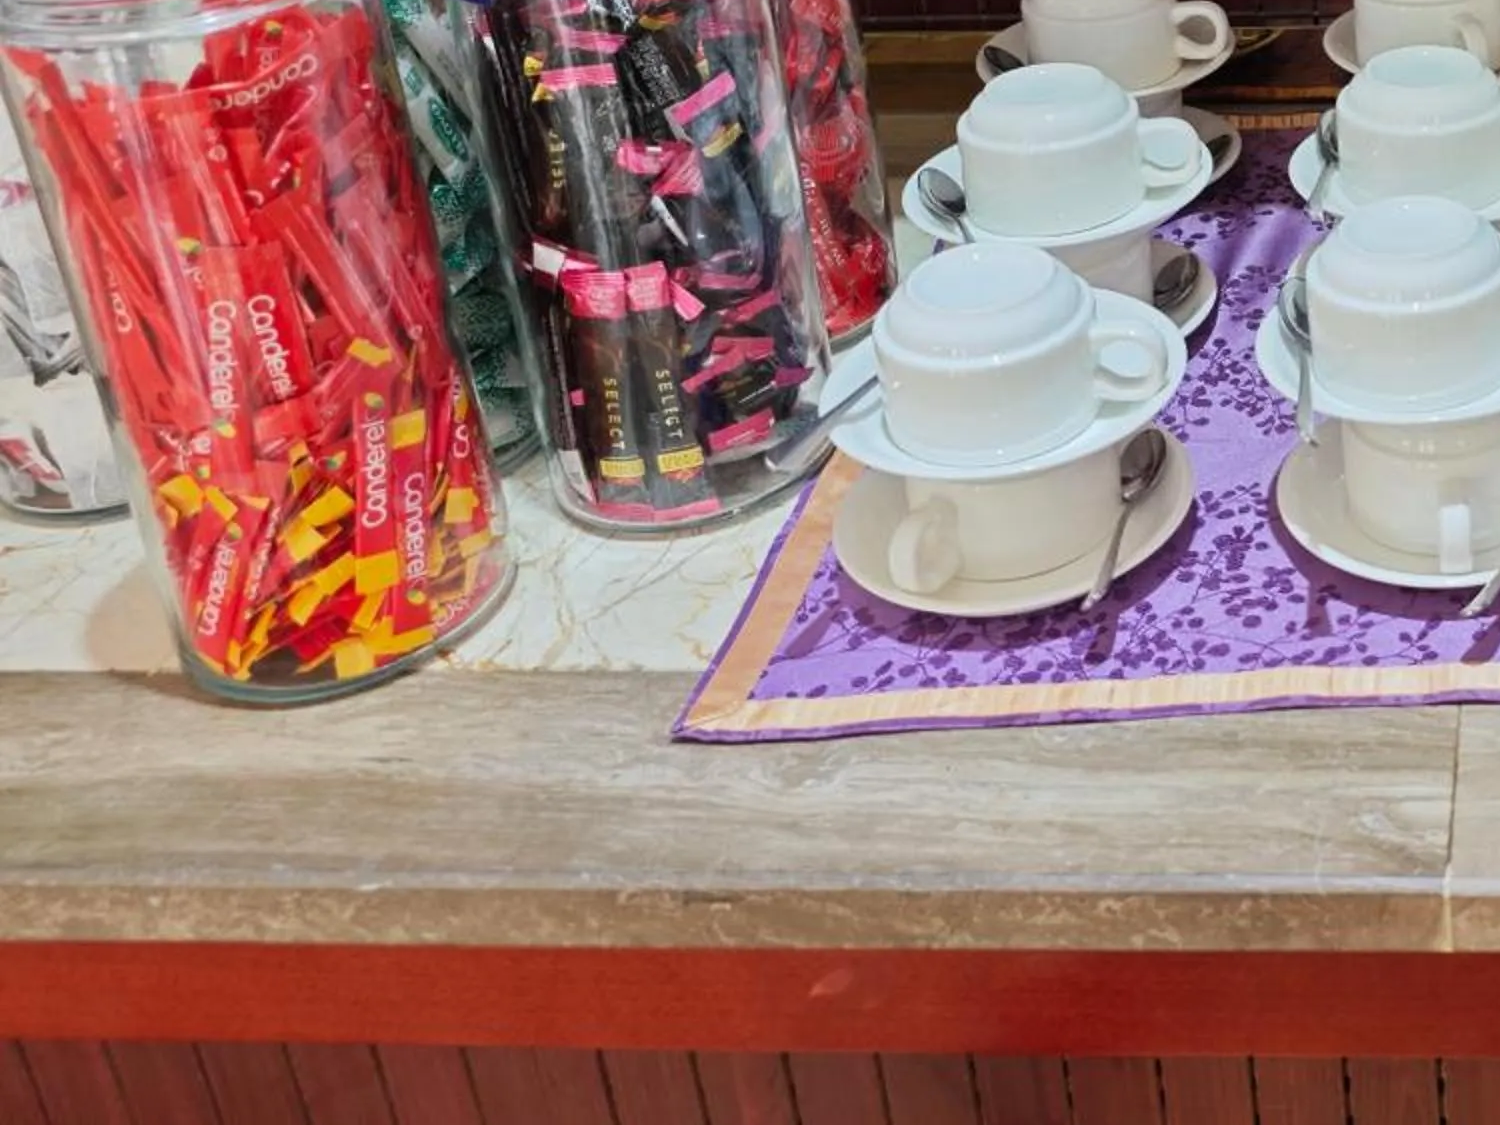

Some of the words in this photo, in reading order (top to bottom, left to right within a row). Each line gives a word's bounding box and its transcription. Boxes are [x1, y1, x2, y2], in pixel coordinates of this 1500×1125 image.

[208, 300, 240, 409] Canderel
[247, 294, 298, 400] Canderel
[603, 378, 627, 451] SELECT
[654, 369, 684, 440] SELECT
[360, 419, 388, 528] Canderel
[403, 472, 427, 580] Canderel
